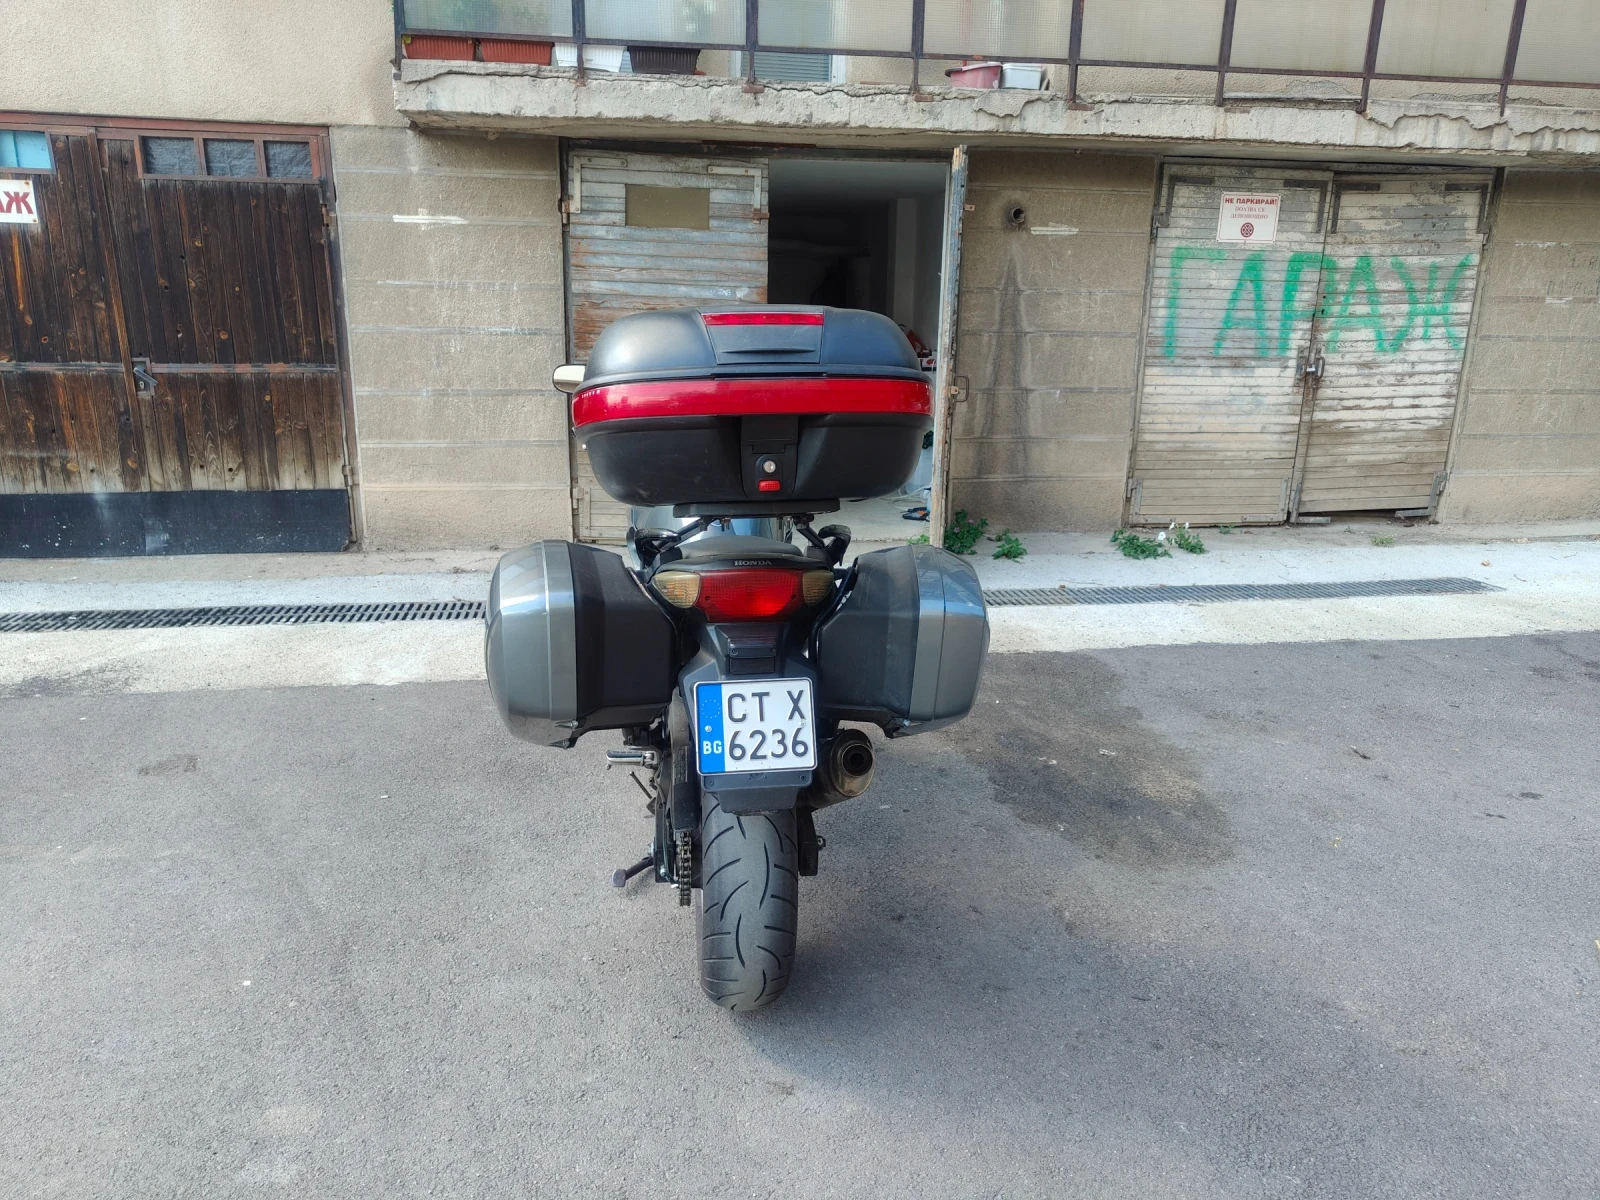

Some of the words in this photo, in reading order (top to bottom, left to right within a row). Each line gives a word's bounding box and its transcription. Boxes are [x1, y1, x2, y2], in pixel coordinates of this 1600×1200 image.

[0, 191, 34, 214] Ж
[1162, 246, 1475, 357] ГАРАЖ
[727, 691, 770, 723] CT
[786, 689, 806, 721] X
[703, 740, 723, 755] BG
[728, 727, 809, 761] 6236
